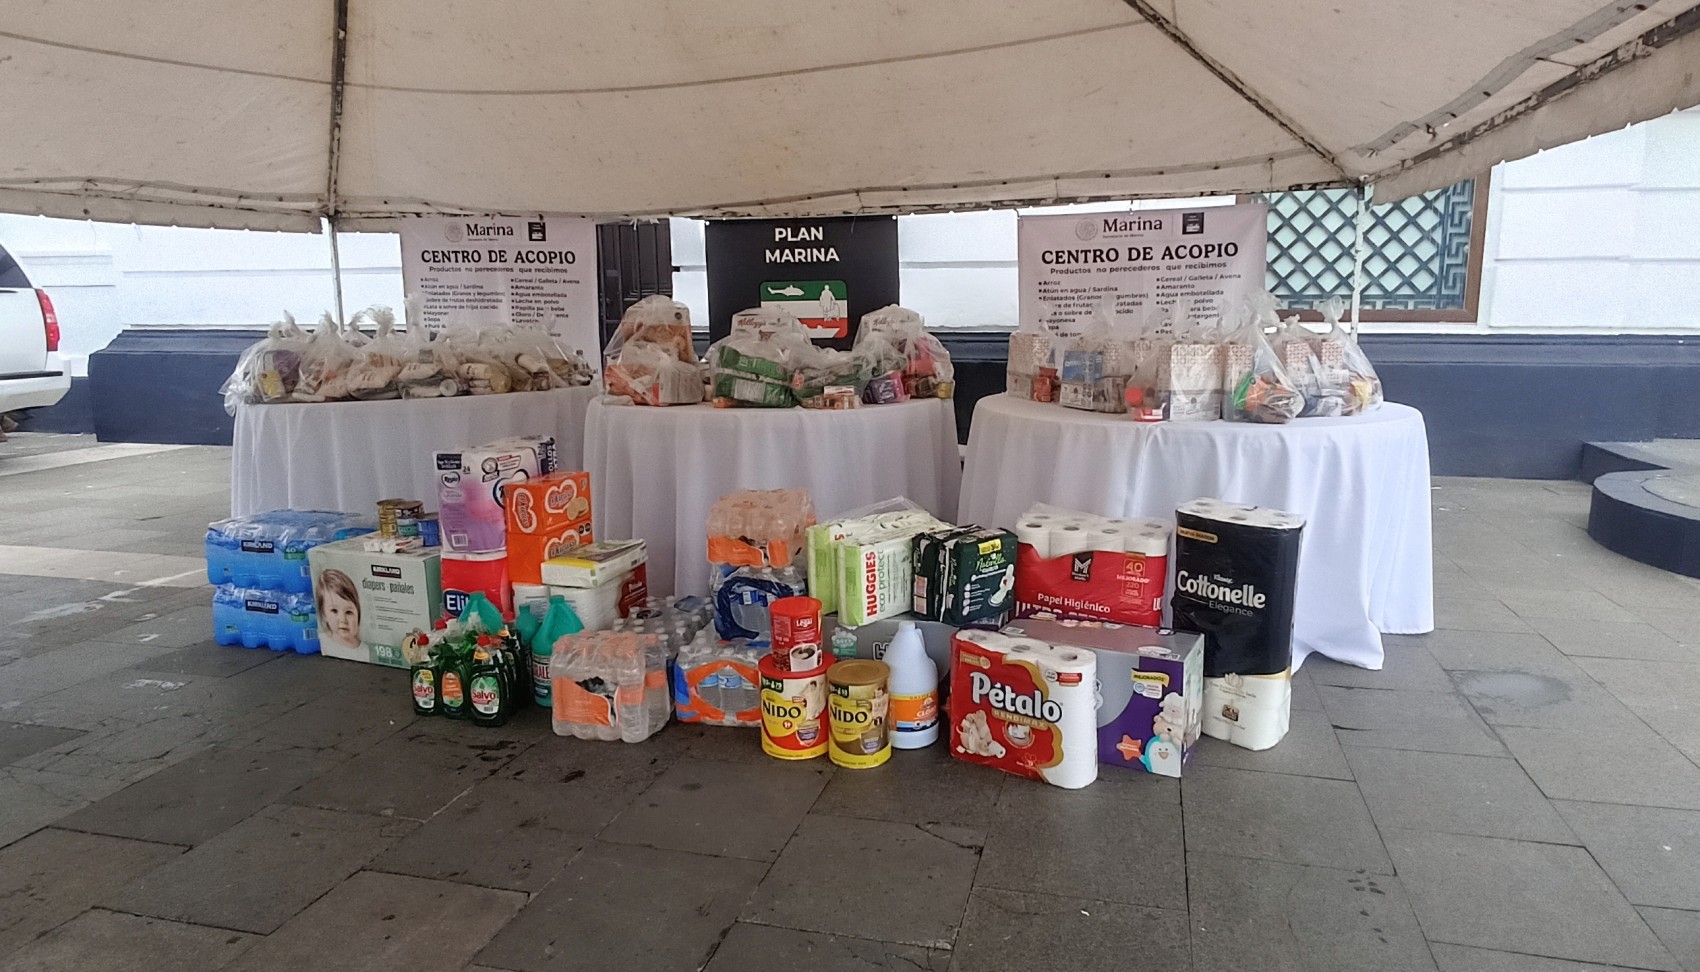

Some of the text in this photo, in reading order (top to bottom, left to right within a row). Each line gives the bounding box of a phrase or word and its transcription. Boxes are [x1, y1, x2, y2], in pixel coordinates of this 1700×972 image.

[466, 223, 514, 236] Marina
[1102, 218, 1162, 232] Marina
[774, 226, 824, 242] PLAN
[421, 250, 576, 264] CENTRO DE ACOPIO
[765, 248, 840, 263] MARINA
[1042, 242, 1238, 265] CENTRO DE ACOPIO
[1110, 264, 1160, 273] perecederos
[373, 566, 400, 575] KIRKLAND
[1126, 562, 1143, 573] 40
[362, 578, 415, 594] diapers pañales
[865, 551, 878, 617] HUGGIES
[1178, 570, 1266, 609] Cottonelle
[248, 601, 277, 610] KIRKLAND
[446, 594, 469, 611] Eli
[1037, 593, 1062, 606] Papel
[1064, 598, 1111, 614] Higiénico
[1209, 601, 1254, 616] Elegance
[374, 645, 393, 658] 198
[414, 684, 434, 694] Salvo
[472, 689, 496, 700] Salvo
[969, 672, 1062, 723] Pétalo
[762, 700, 802, 718] NIDO
[830, 704, 868, 723] NIDO
[994, 709, 1045, 728] RENDIMAX
